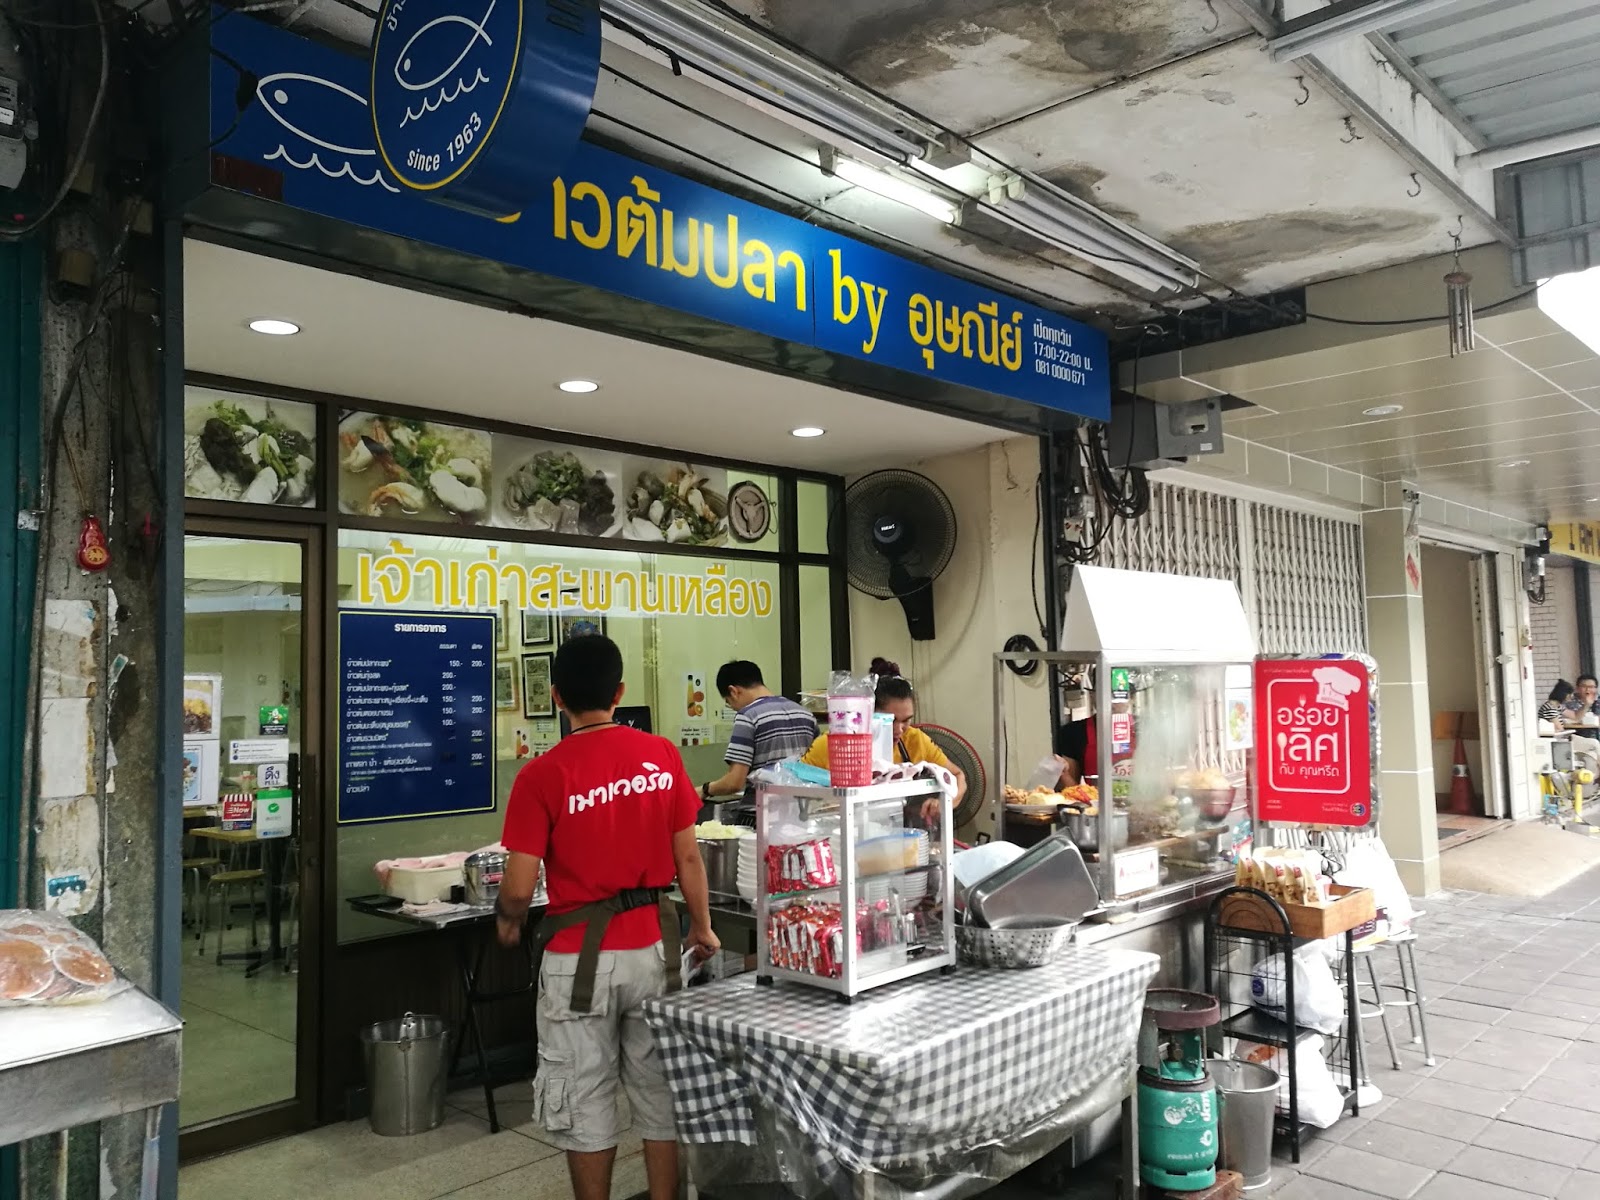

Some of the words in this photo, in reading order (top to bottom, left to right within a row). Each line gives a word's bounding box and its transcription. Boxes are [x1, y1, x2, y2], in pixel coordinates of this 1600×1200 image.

[407, 149, 440, 172] since
[446, 112, 483, 162] 1963
[828, 249, 888, 354] by
[908, 293, 1023, 371] อุษณีย์
[1033, 318, 1072, 347] เปิดทุกวัน
[1033, 341, 1081, 368] 17:00-22:00
[1084, 356, 1093, 371] น.
[1035, 359, 1050, 376] 081
[1051, 363, 1071, 382] 0000
[1071, 369, 1086, 386] 671
[356, 539, 774, 618] เจ้าเก่าสะพานเหลือง
[394, 623, 447, 633] รายการอาหาร
[1277, 697, 1339, 726] อร่อย
